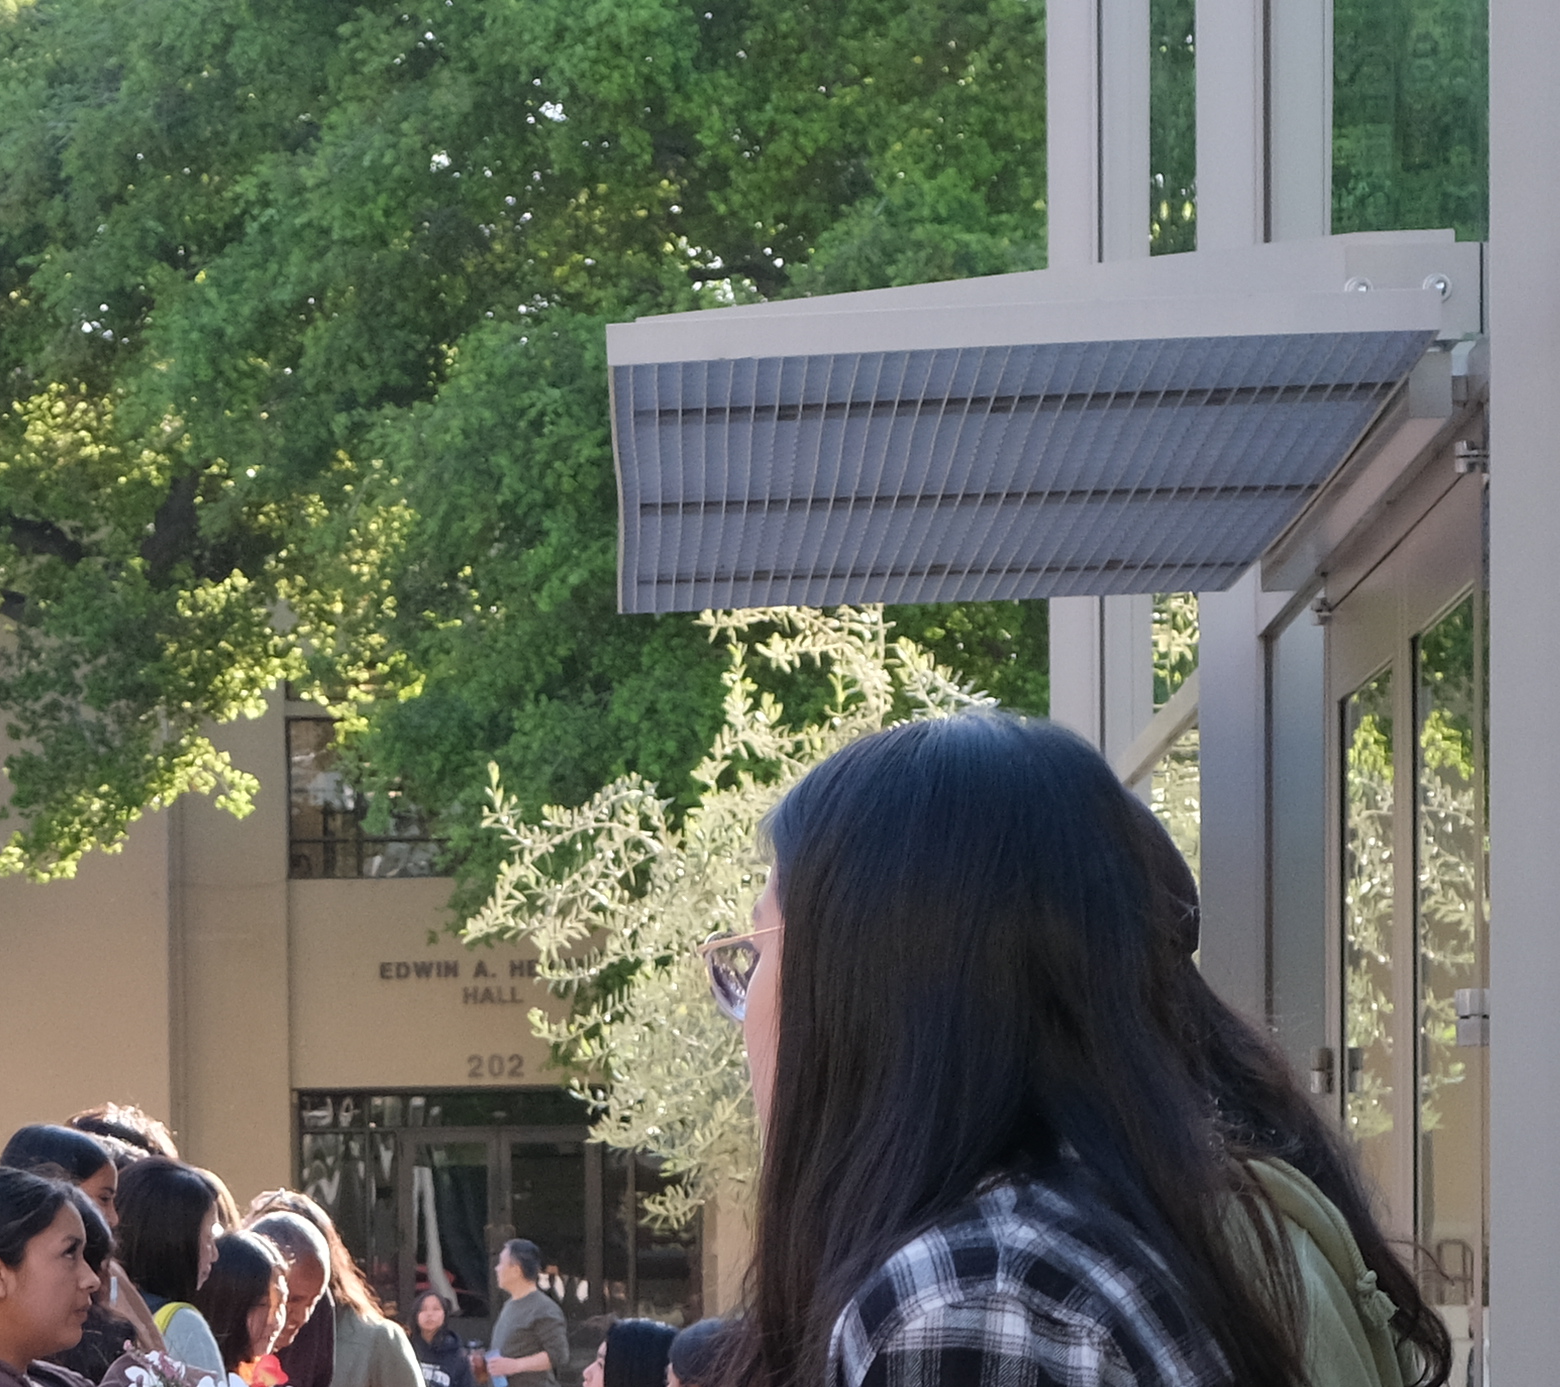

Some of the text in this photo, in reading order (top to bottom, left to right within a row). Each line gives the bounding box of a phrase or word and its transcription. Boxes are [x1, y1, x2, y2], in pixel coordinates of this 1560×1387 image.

[379, 960, 459, 980] EDWIN
[473, 959, 497, 978] A.
[463, 986, 524, 1004] HALL
[467, 1053, 524, 1078] 202
